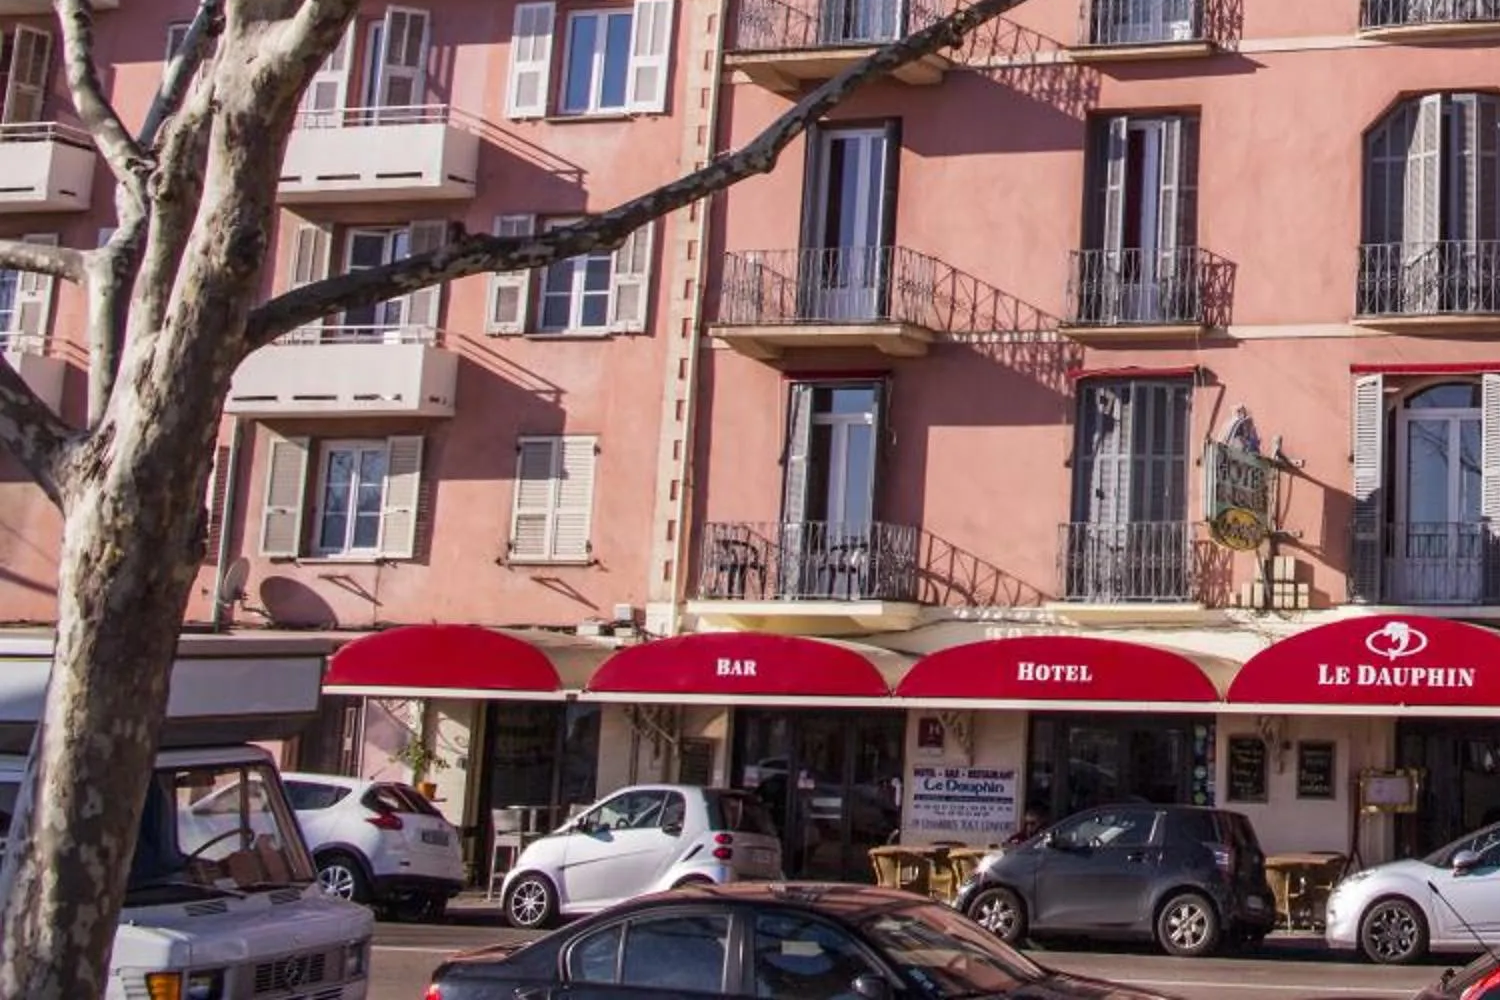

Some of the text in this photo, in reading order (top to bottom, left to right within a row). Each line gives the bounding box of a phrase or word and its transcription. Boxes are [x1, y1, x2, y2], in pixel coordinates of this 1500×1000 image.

[716, 658, 757, 676] BAR
[1017, 661, 1093, 682] HOTEL
[1317, 663, 1476, 687] LE DAUPHIN
[945, 780, 1005, 796] Dauphin
